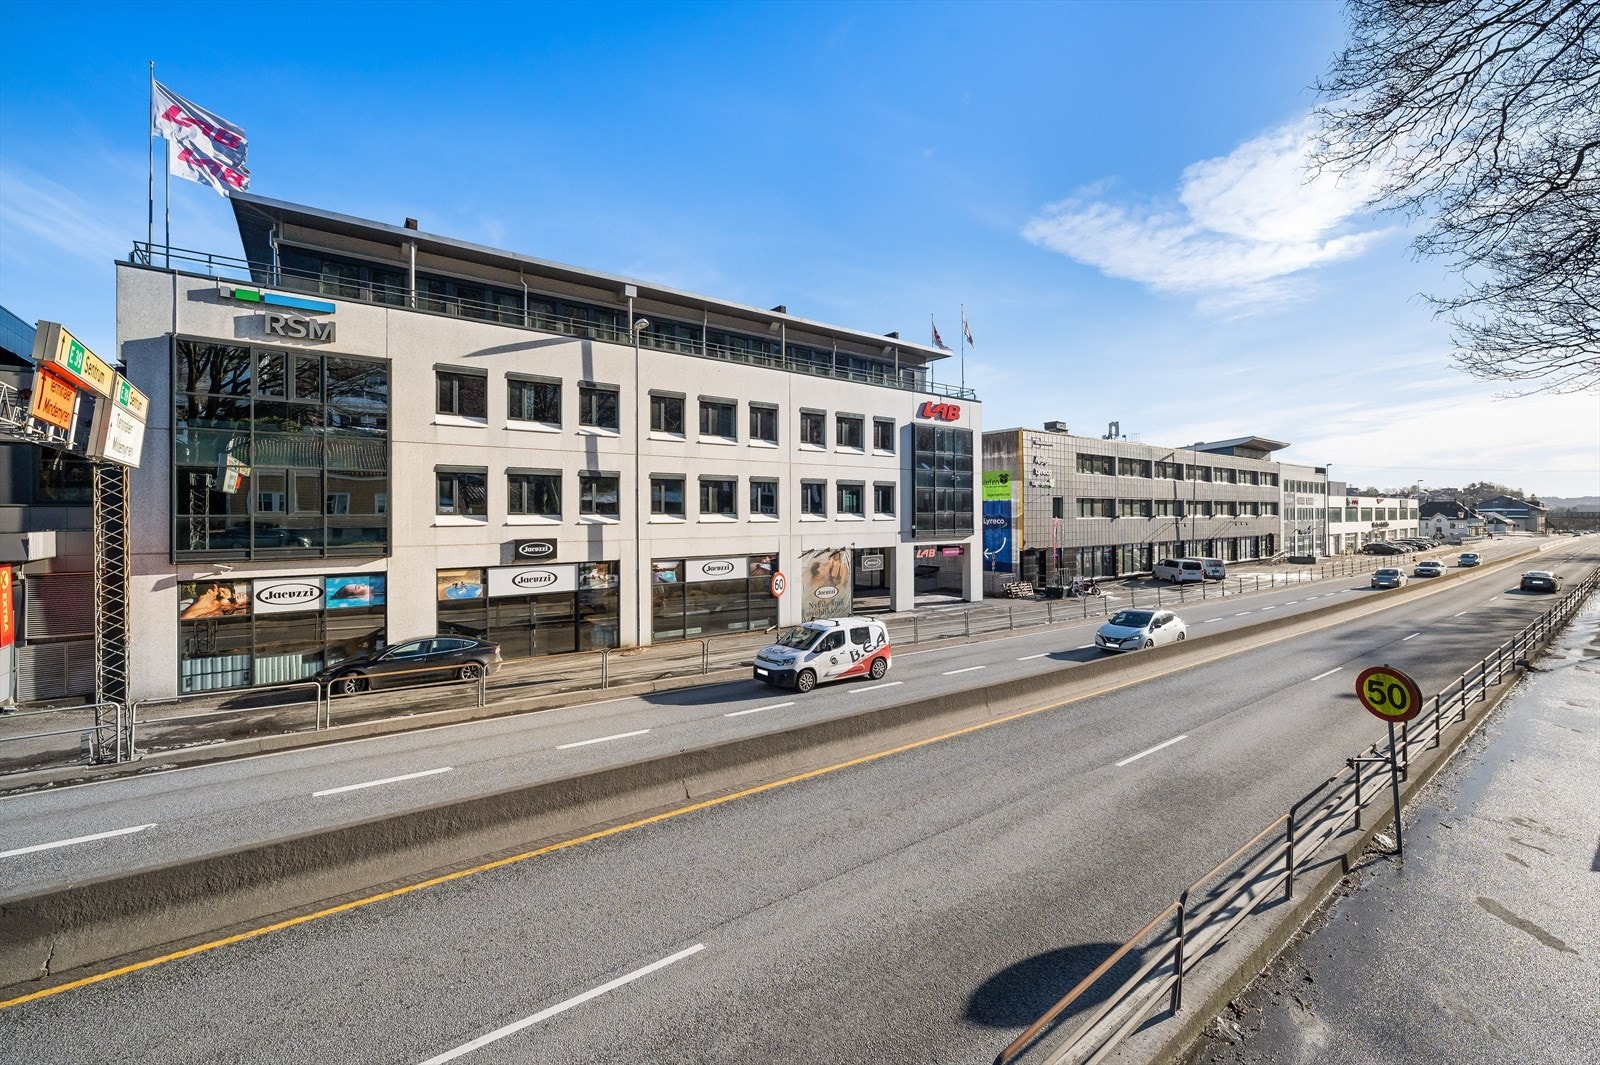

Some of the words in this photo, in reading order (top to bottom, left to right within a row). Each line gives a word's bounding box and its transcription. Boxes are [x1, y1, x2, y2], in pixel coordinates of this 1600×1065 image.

[162, 105, 242, 149] LAB
[177, 148, 245, 188] LAB
[265, 311, 336, 343] RSM
[69, 347, 75, 363] E
[74, 350, 83, 368] 39
[84, 356, 105, 385] Sentrum
[923, 401, 961, 421] LAB
[983, 517, 1005, 525] Lyreco
[523, 545, 548, 553] Jacuzzi
[916, 548, 936, 558] LAB
[706, 563, 730, 572] Jacuzzi
[517, 574, 551, 584] Jacuzzi
[774, 578, 784, 590] 60
[264, 588, 314, 600] Jacuzzi
[1368, 679, 1407, 710] 50
